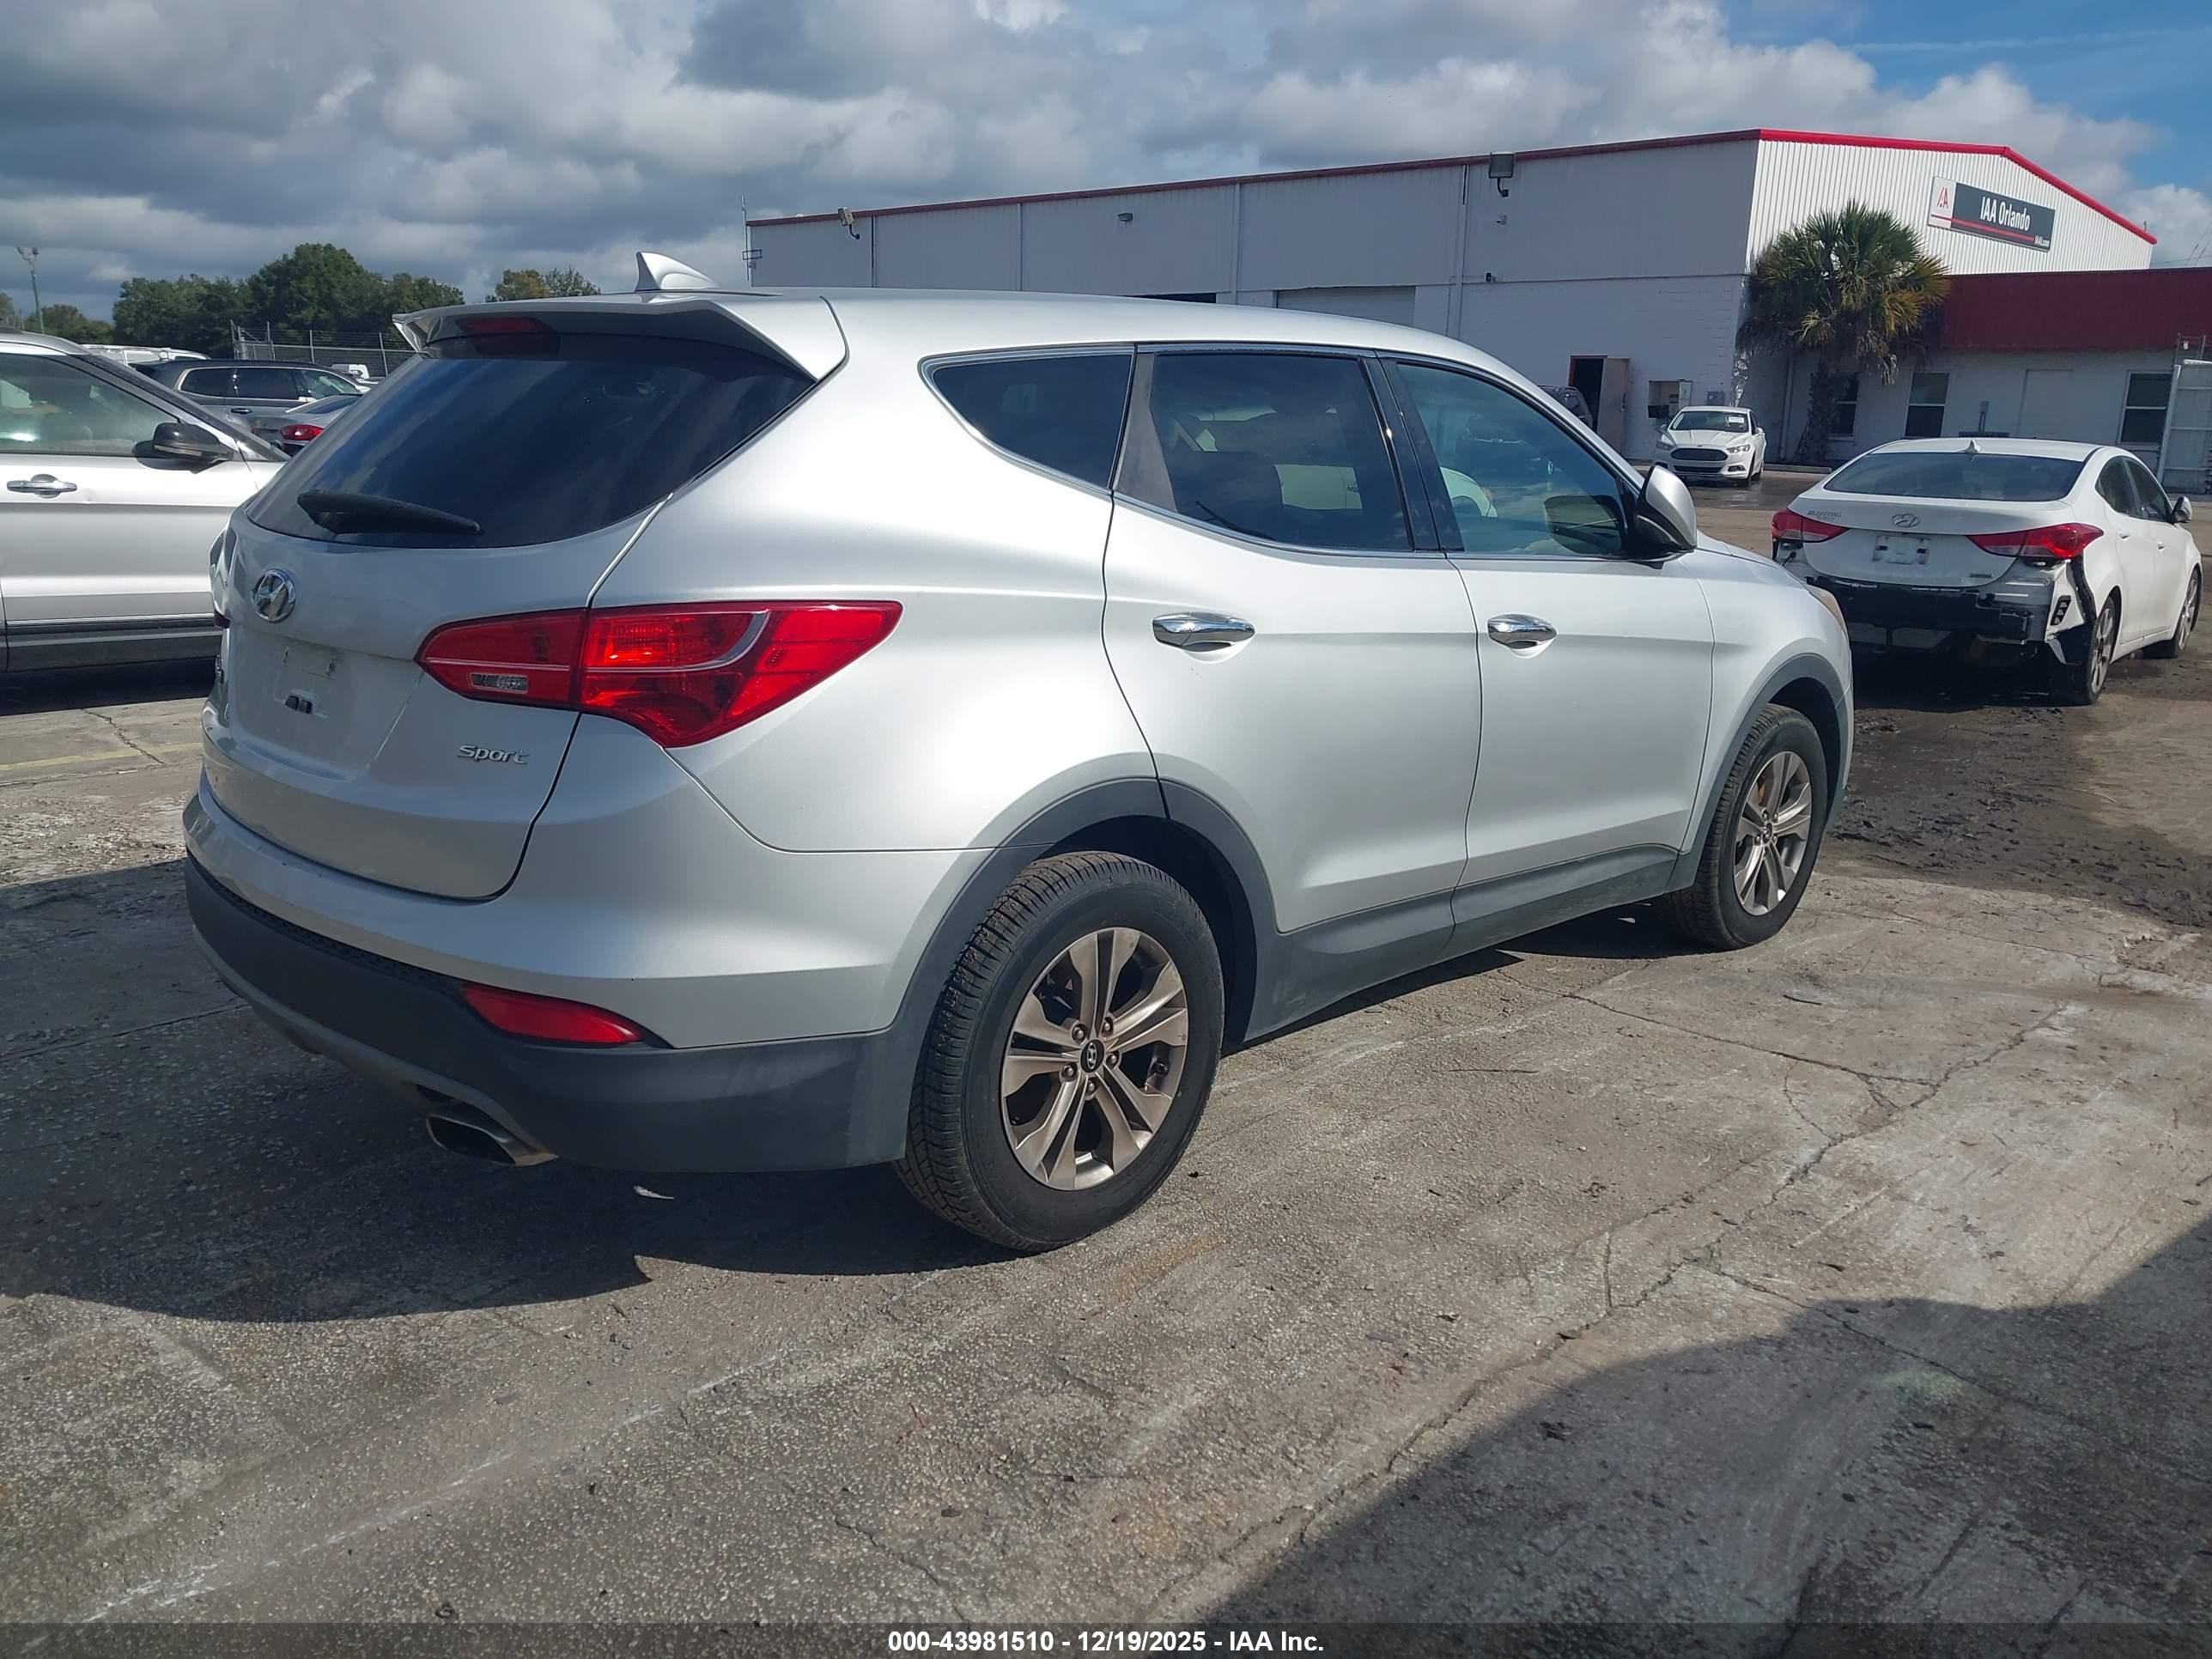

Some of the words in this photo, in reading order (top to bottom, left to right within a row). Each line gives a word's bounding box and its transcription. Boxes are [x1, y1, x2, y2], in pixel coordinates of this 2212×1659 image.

[1980, 196, 1996, 223] IAA
[1998, 201, 2031, 231] Orlando
[459, 744, 530, 764] Sport
